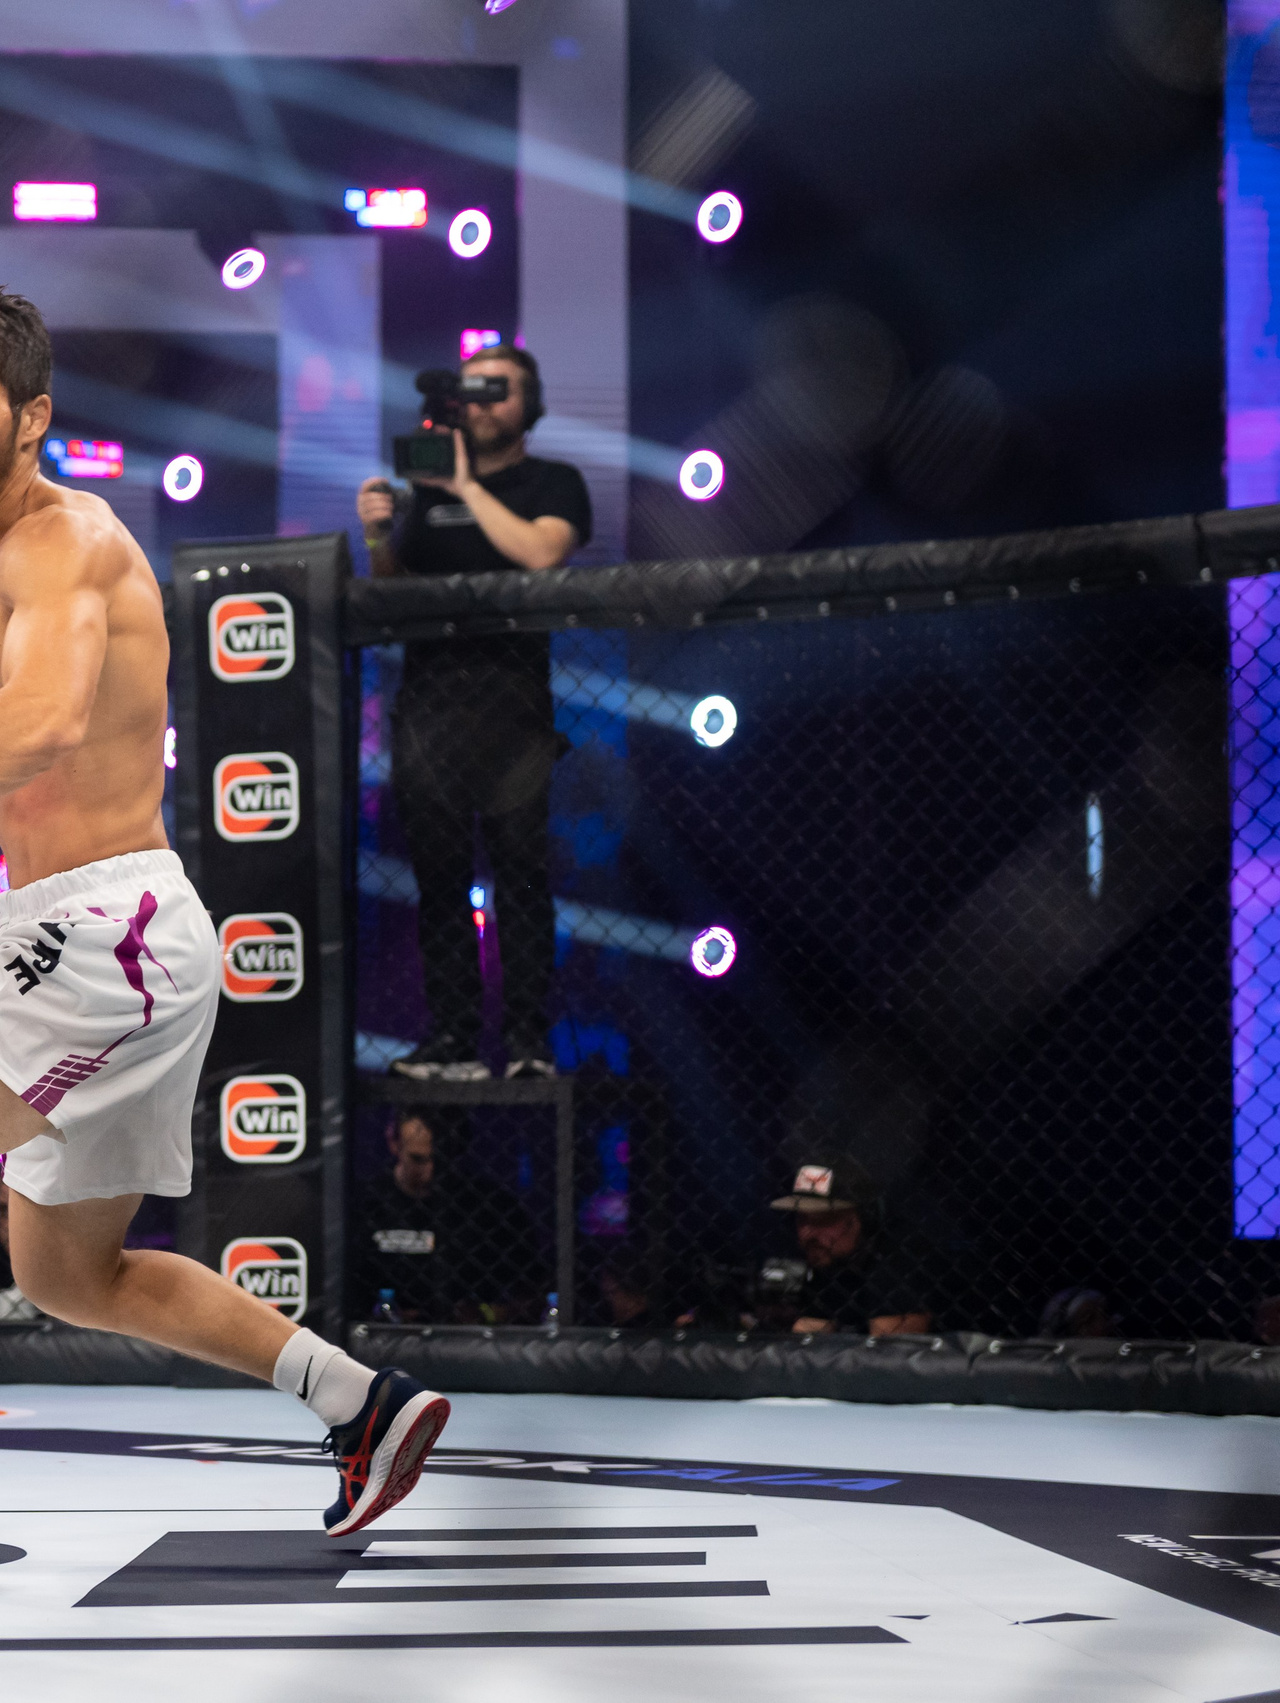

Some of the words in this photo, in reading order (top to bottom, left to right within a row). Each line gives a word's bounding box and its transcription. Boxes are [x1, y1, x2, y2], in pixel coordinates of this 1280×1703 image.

[230, 623, 287, 650] Win
[234, 783, 291, 810] Win
[236, 944, 295, 971] Win
[239, 1106, 297, 1133] Win
[241, 1268, 300, 1296] Win
